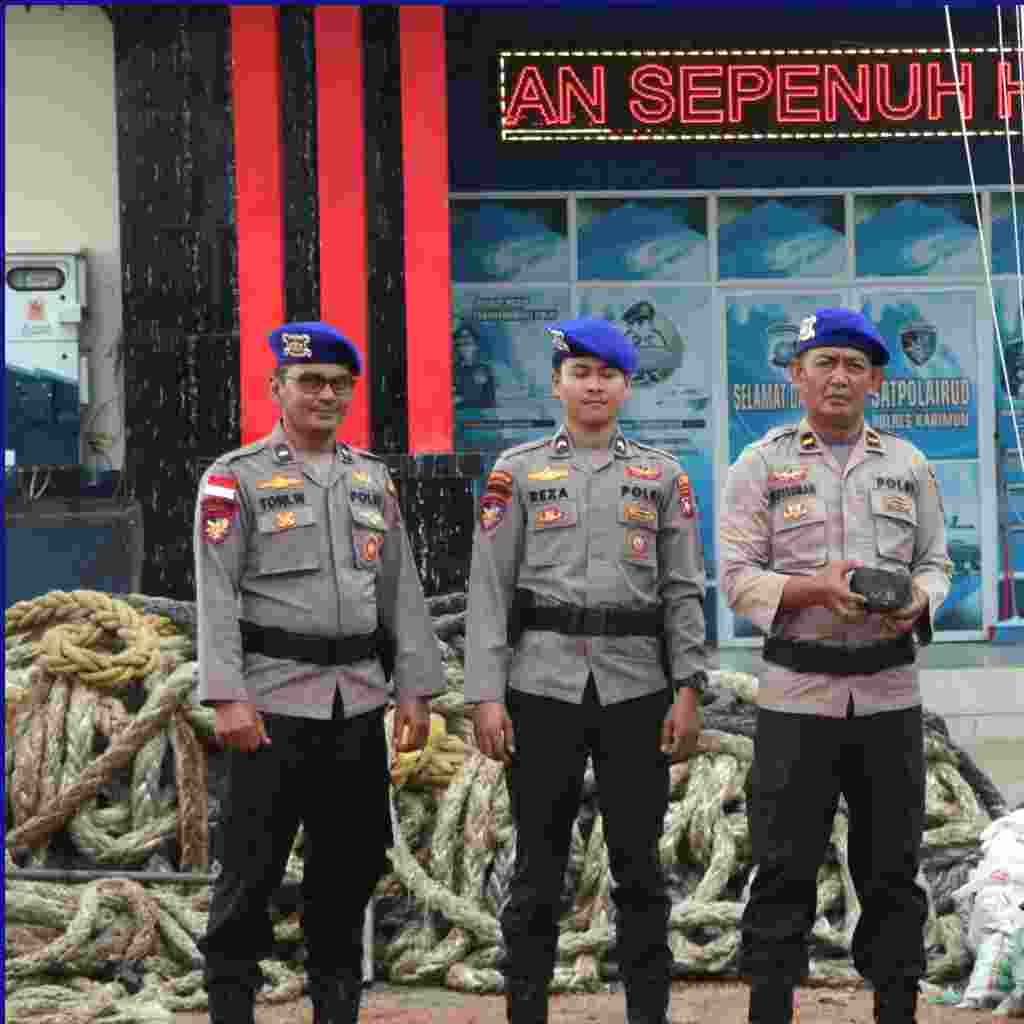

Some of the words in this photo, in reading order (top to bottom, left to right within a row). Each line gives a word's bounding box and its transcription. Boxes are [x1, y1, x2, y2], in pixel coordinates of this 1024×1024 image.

[502, 65, 605, 125] AN
[628, 60, 973, 124] SEPENUH
[733, 383, 786, 409] SELAMAT
